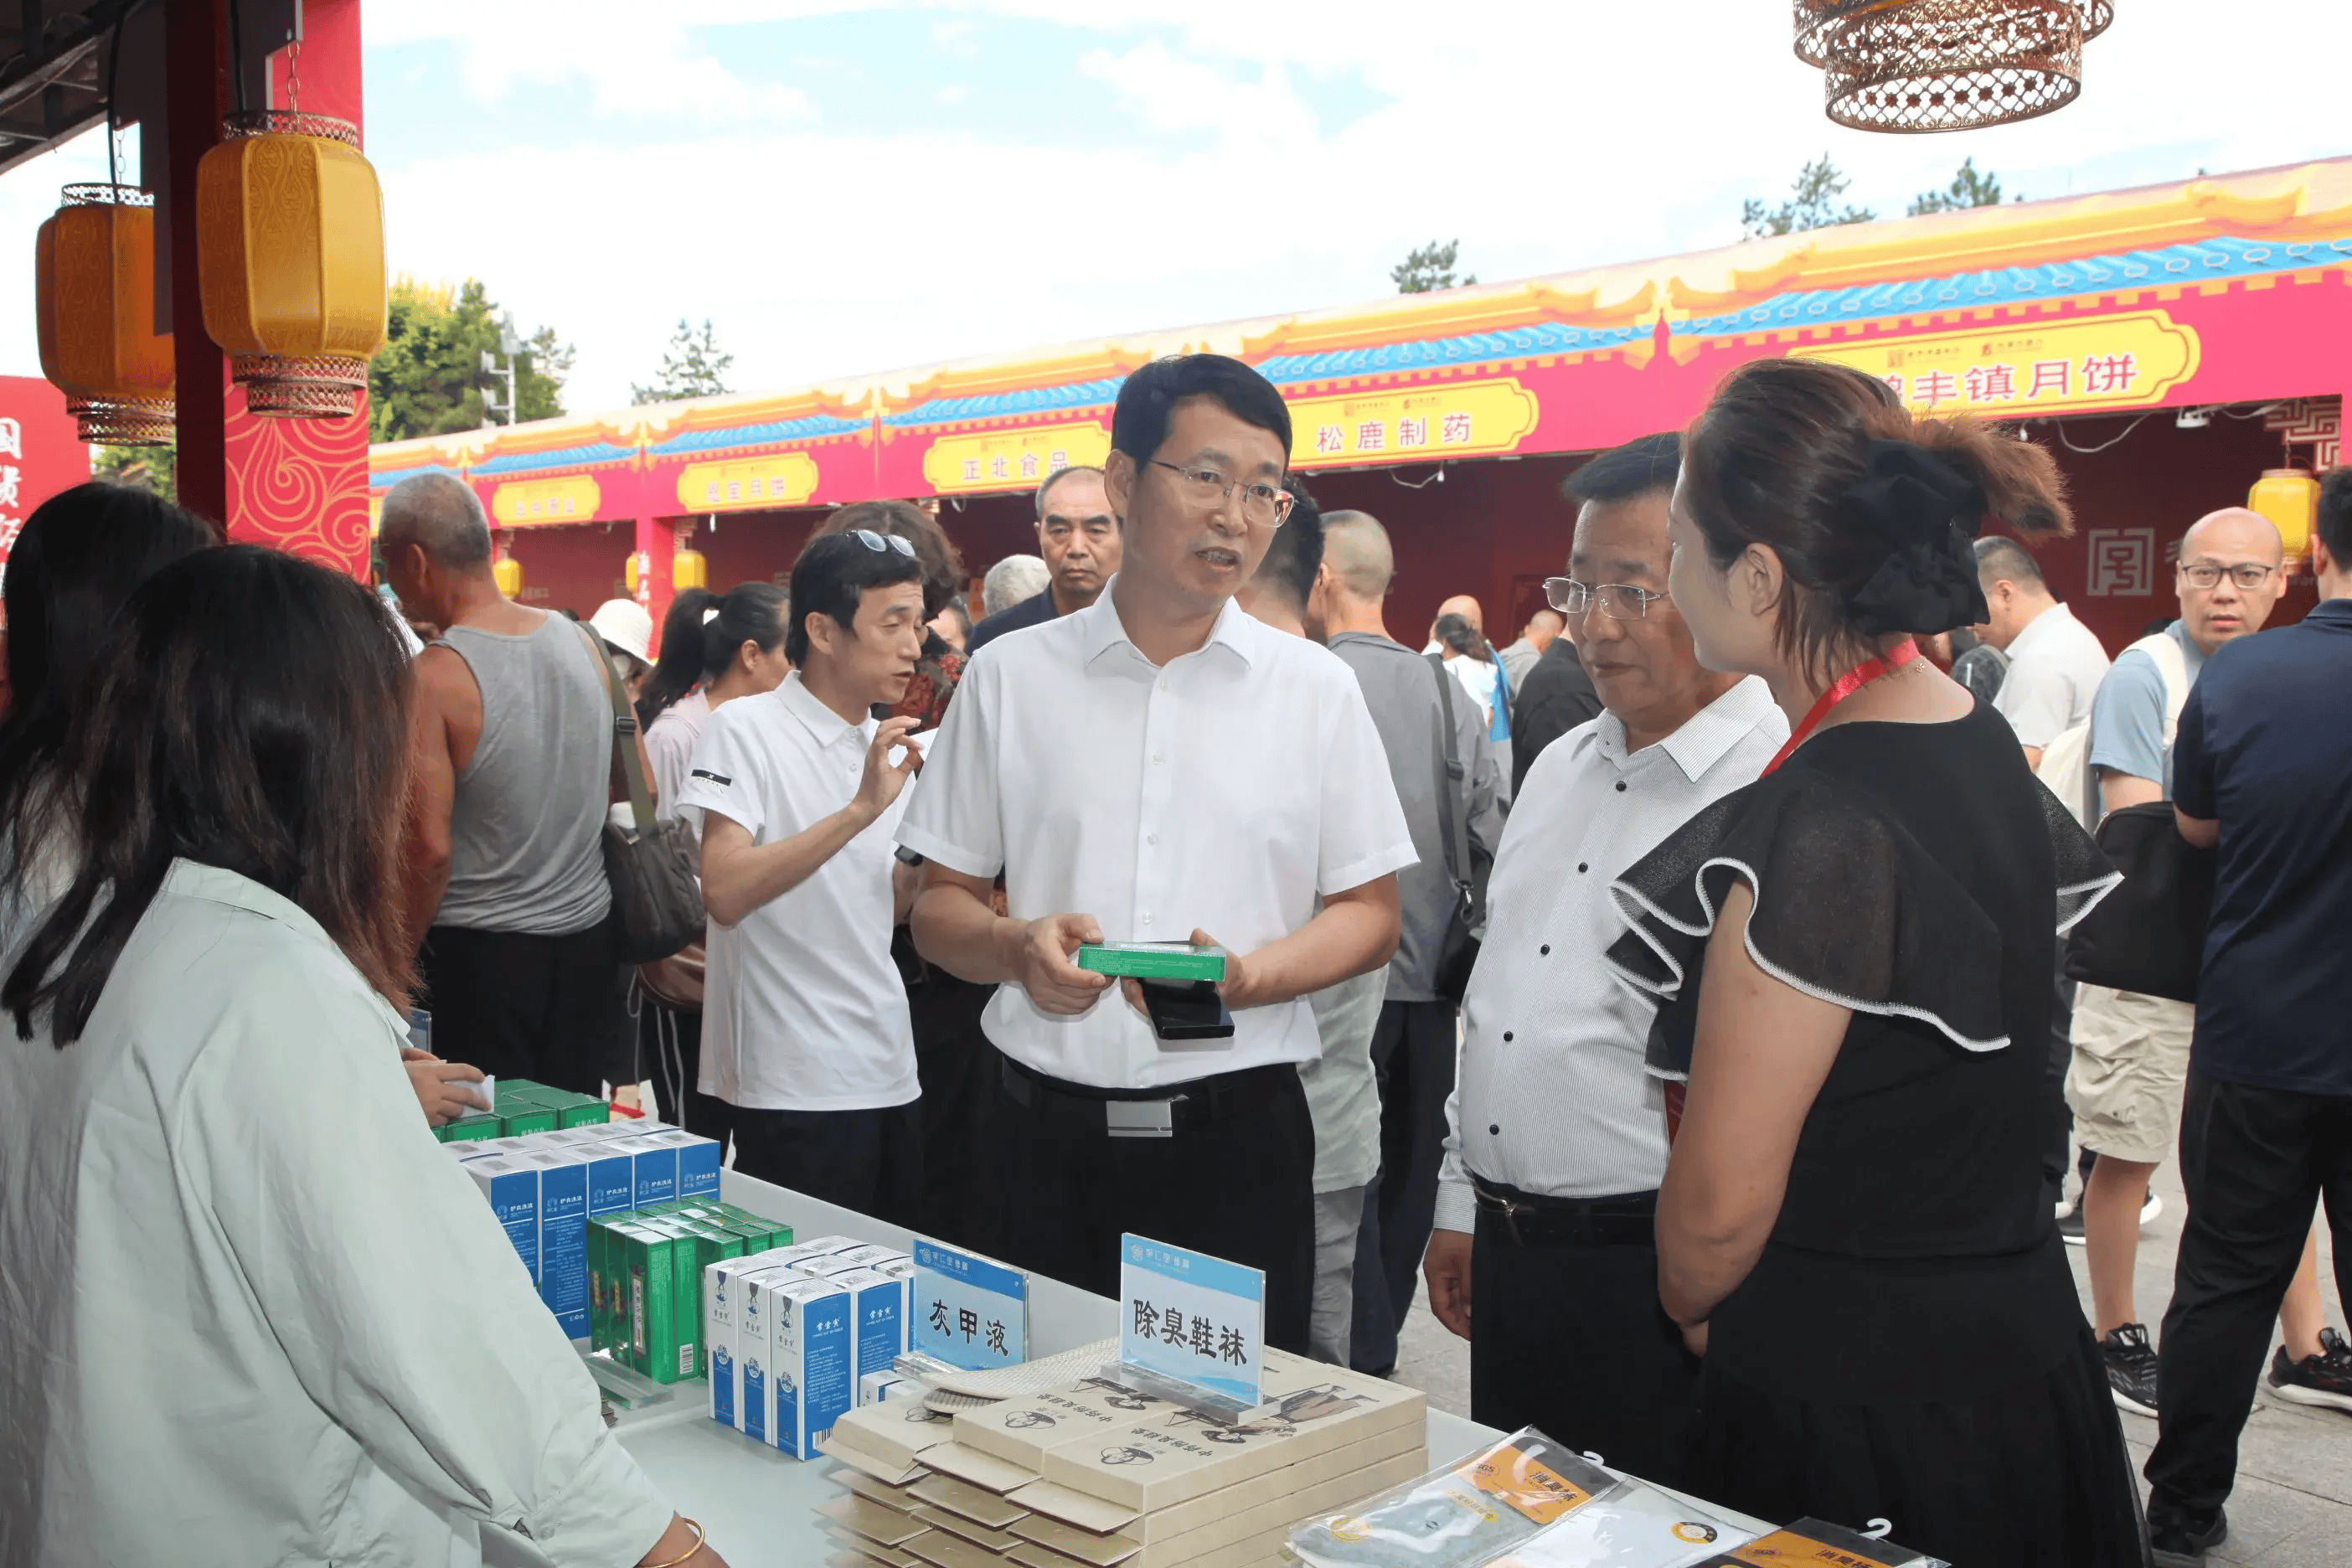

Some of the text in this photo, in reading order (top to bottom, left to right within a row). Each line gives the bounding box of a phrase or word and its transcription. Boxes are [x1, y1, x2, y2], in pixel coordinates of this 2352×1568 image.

[1317, 413, 1471, 453] 松鹿制药
[963, 451, 1068, 480] 正北食品
[929, 1299, 1008, 1357] 灰甲液
[1133, 1299, 1247, 1366] 除臭鞋袜
